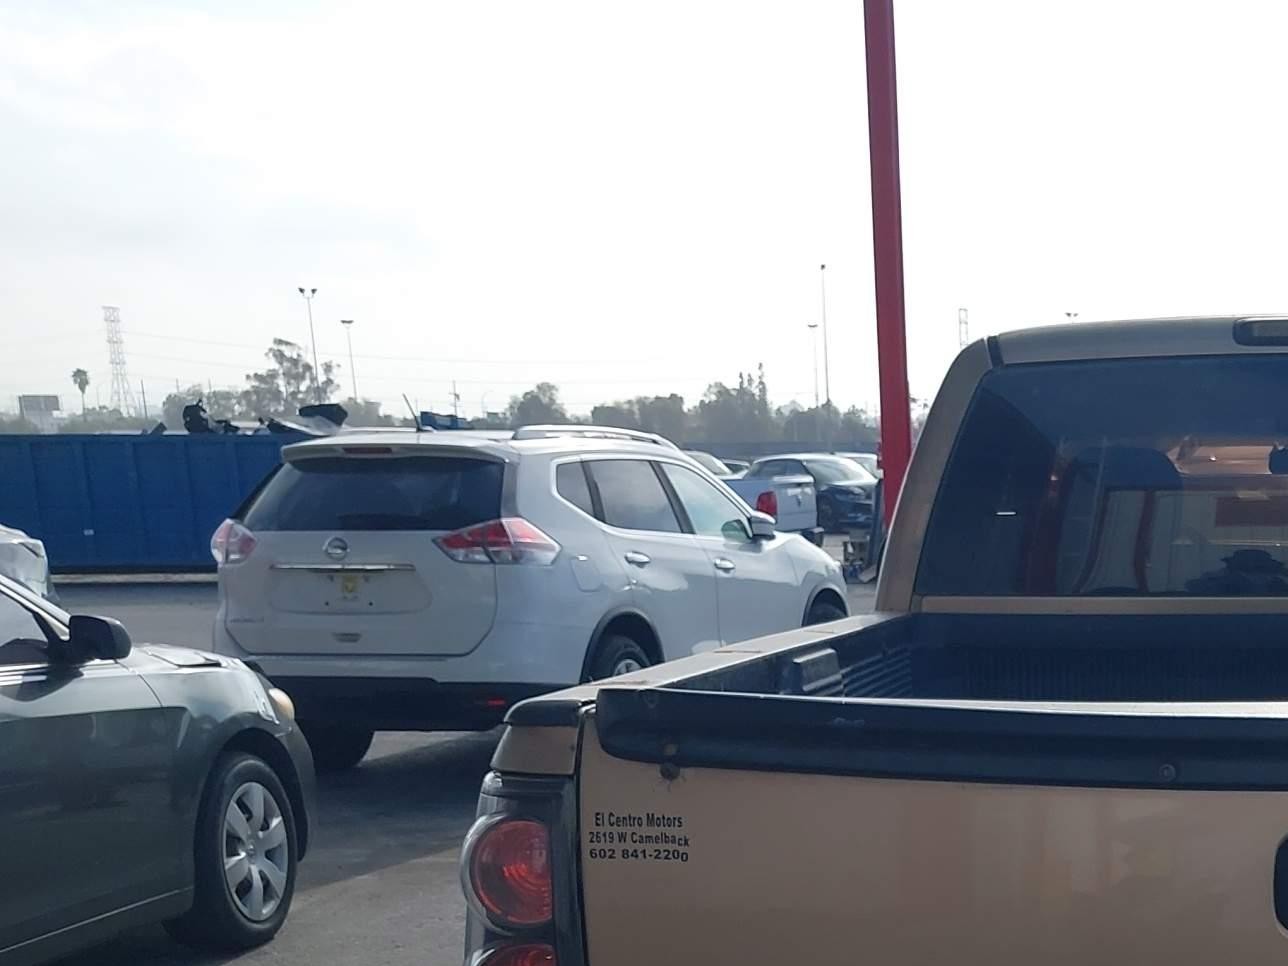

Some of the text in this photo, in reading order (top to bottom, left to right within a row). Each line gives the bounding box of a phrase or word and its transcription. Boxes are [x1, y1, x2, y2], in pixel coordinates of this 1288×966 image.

[594, 811, 683, 828] El Centro Motors
[617, 831, 628, 844] W
[630, 831, 690, 847] Camelback
[589, 848, 689, 863] 602 841-2200
